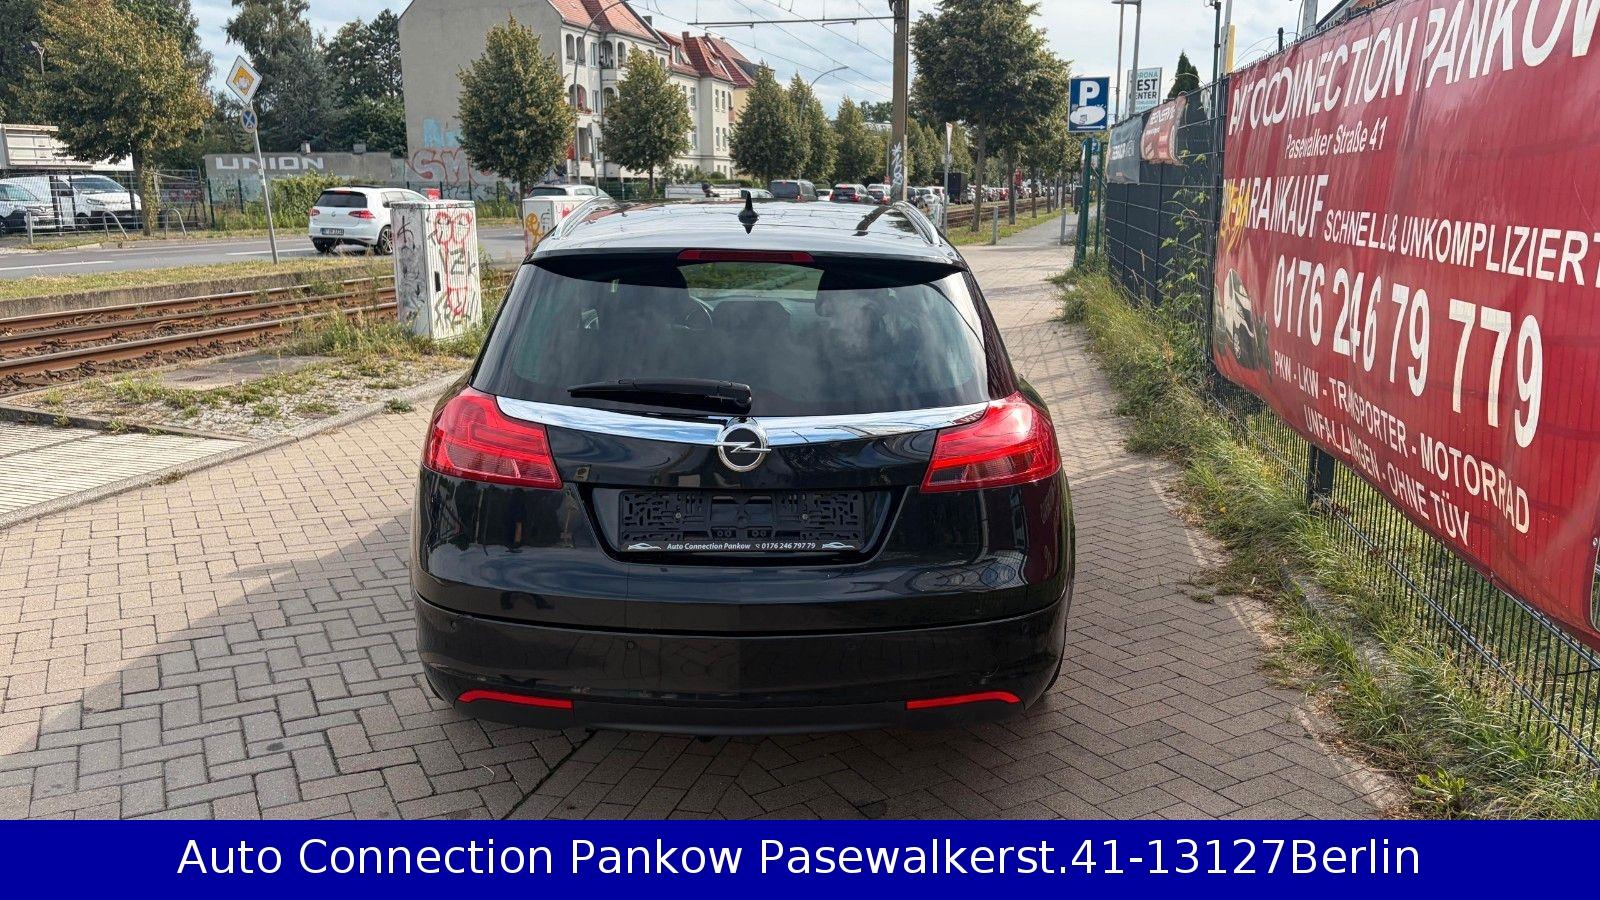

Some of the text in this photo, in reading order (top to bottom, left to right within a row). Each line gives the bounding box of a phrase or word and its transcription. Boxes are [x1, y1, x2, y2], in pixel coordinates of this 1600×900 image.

[1080, 80, 1100, 107] P
[1136, 79, 1158, 91] EST
[1285, 116, 1388, 160] Pasewalker Straße 41
[215, 156, 324, 170] UNION
[1273, 254, 1543, 448] 0176 246 79 779
[1274, 349, 1292, 384] PKW
[1297, 362, 1319, 400] LKW
[1420, 432, 1530, 534] MOTORRAD
[1387, 461, 1430, 521] OHNE
[1430, 490, 1470, 547] TÜV
[667, 542, 684, 550] Auto
[684, 542, 723, 550] Connection
[723, 542, 751, 550] Pankow
